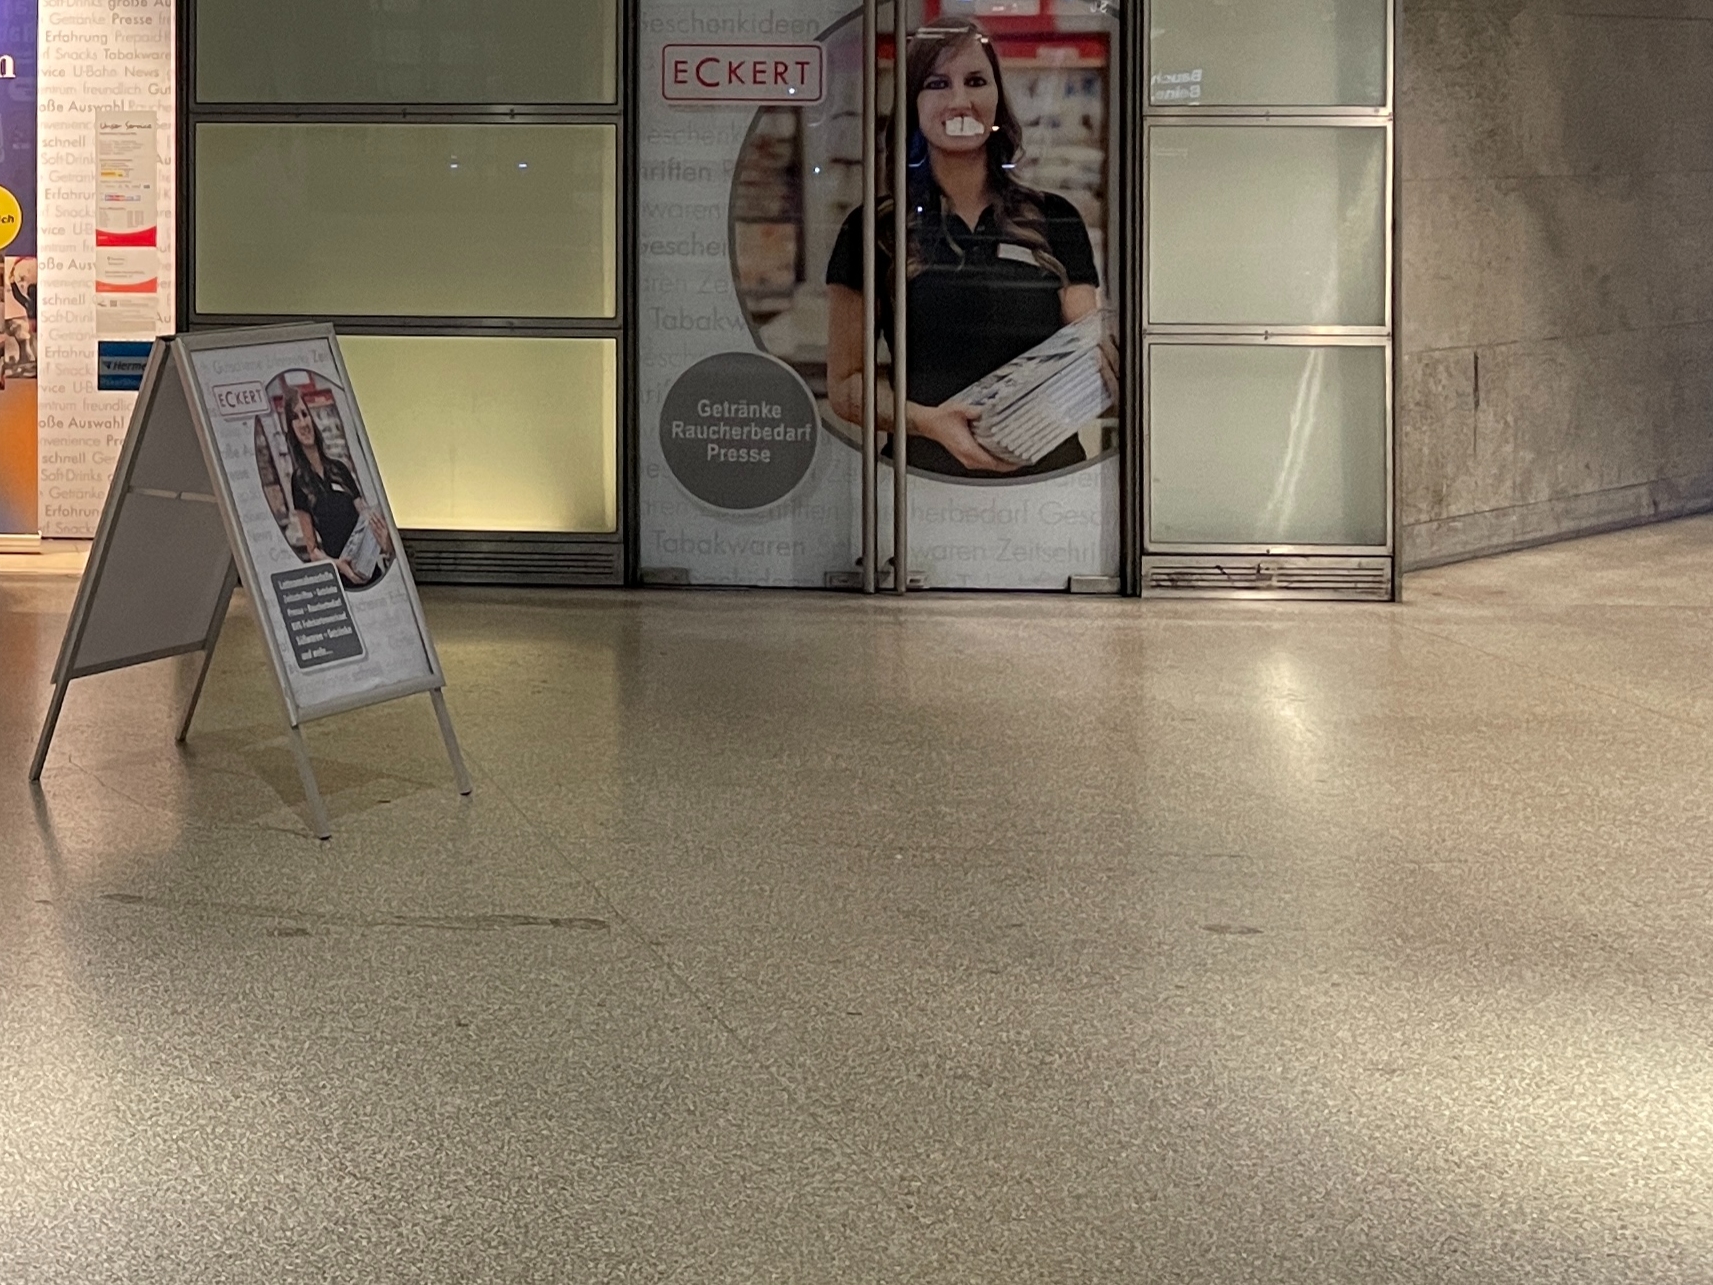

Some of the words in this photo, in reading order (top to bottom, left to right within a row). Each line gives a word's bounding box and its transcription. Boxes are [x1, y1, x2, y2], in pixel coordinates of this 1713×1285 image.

[111, 12, 153, 25] Presse
[45, 30, 108, 46] Erfahrung
[124, 65, 160, 77] News
[672, 56, 812, 89] ECKERT
[68, 100, 125, 113] Auswahl
[217, 388, 264, 410] ECKERT
[697, 398, 782, 418] Getränke
[68, 415, 125, 429] Auswahl
[671, 420, 813, 442] Raucherbedarf
[42, 451, 87, 465] schnell
[706, 443, 772, 463] Presse
